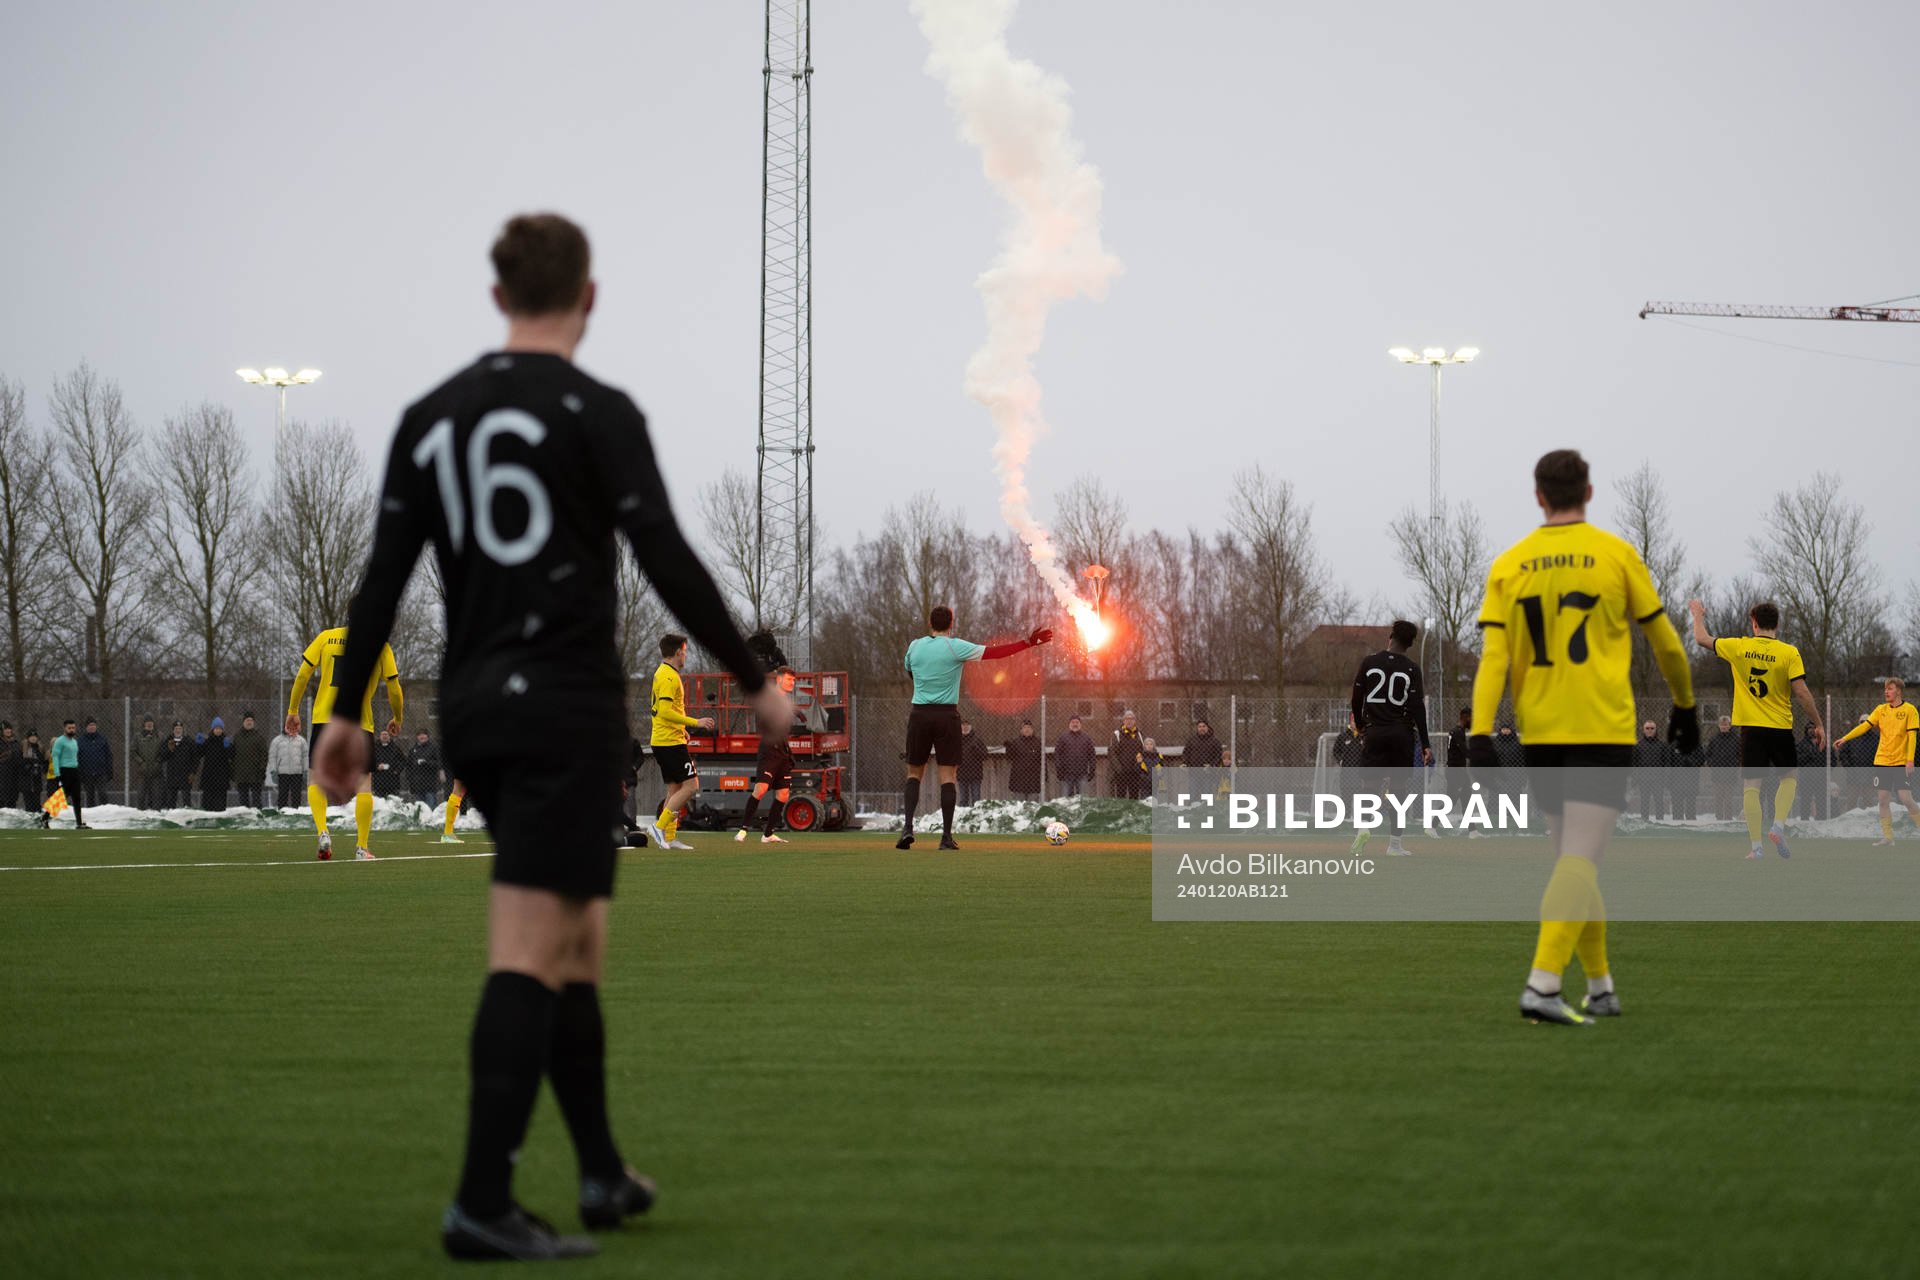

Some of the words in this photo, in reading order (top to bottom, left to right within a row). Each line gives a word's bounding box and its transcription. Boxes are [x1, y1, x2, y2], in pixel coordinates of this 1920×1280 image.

[412, 409, 552, 566] 16
[1520, 553, 1595, 572] STROUD
[1516, 590, 1600, 667] 17
[1366, 668, 1411, 706] 20
[1749, 666, 1769, 698] 5
[724, 779, 744, 787] renta
